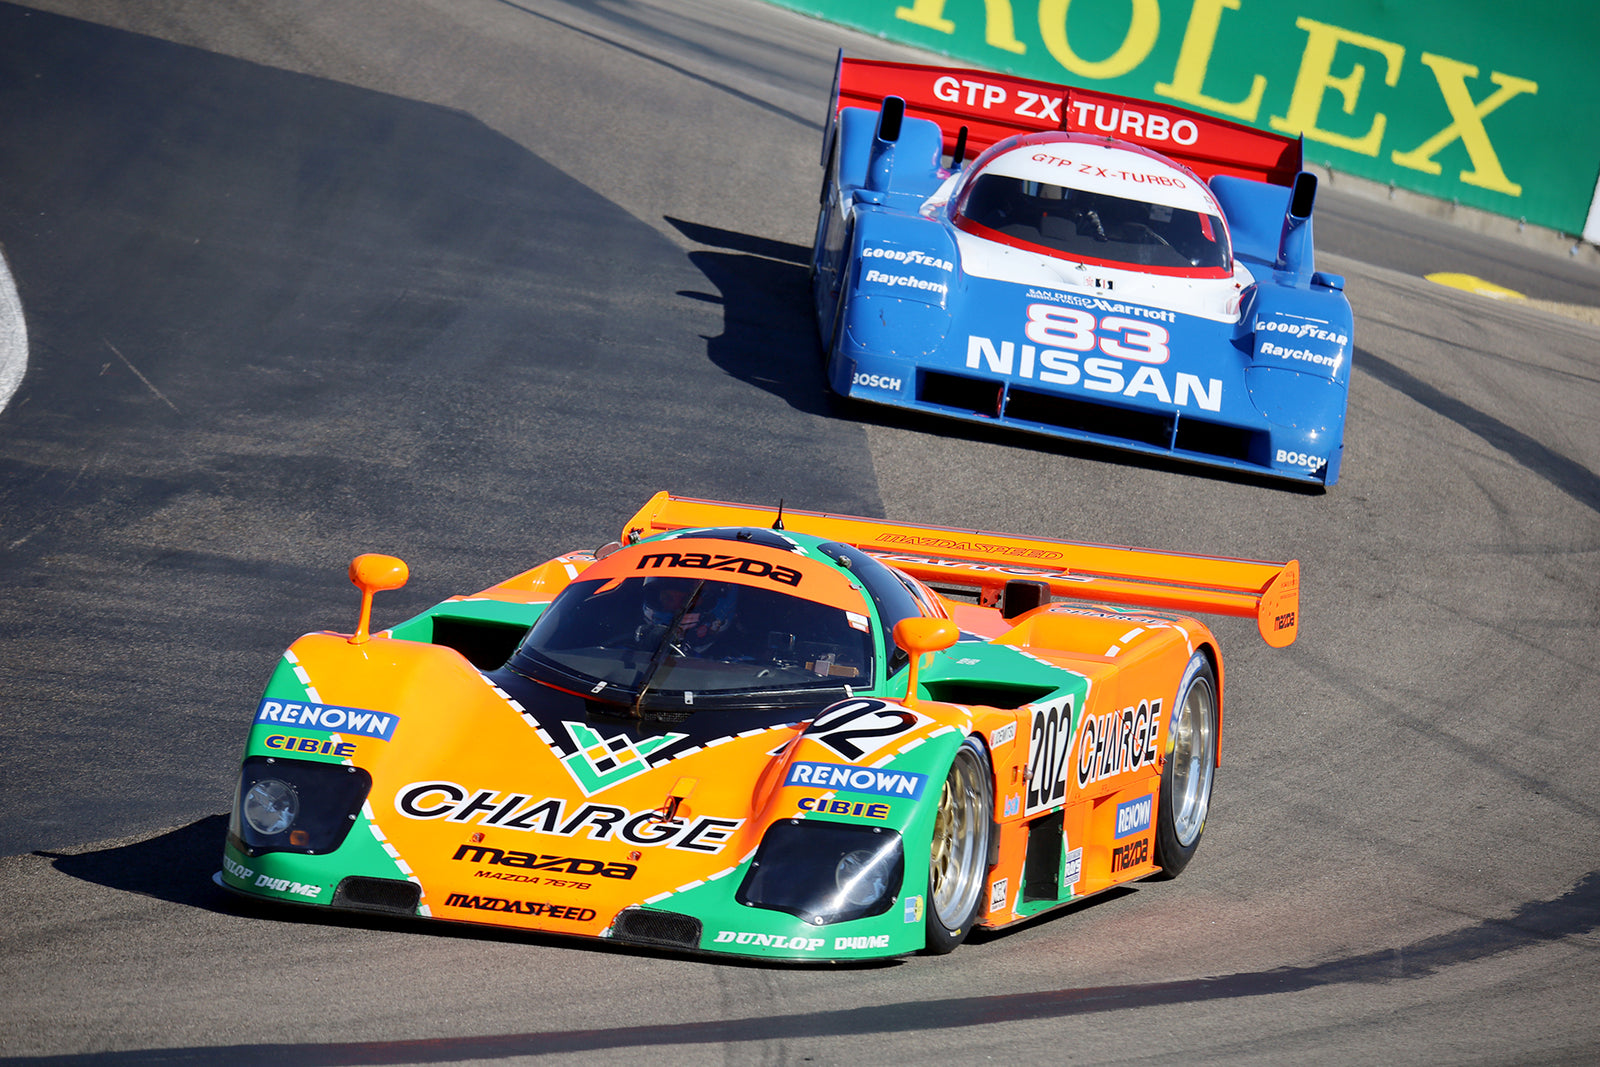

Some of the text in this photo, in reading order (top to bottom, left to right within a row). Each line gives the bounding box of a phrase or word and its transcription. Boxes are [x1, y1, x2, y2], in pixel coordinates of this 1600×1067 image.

[933, 76, 1007, 110] GTP
[1032, 153, 1187, 190] GTP ZX-TURBO
[865, 269, 948, 294] Raychem
[1027, 288, 1095, 304] SAN DIEGO
[1084, 298, 1177, 324] Marriott
[1025, 303, 1170, 364] 83
[1260, 342, 1343, 369] Raychem
[965, 335, 1223, 412] NISSAN
[1275, 449, 1327, 470] BOSCH
[875, 533, 1064, 560] MAZDASPEED
[636, 553, 803, 587] mazda
[259, 701, 390, 735] RENOWN
[1027, 702, 1072, 809] 202
[1077, 698, 1163, 789] CHARGE
[791, 764, 918, 795] RENOWN
[394, 780, 746, 855] CHARGE
[1117, 800, 1151, 833] RENOWN
[452, 844, 638, 880] mazda
[1111, 838, 1149, 873] mazda
[474, 870, 592, 890] MAZDA 767B
[444, 893, 597, 922] MAZDASPEED
[713, 930, 889, 951] DUNLOP D40/M2
